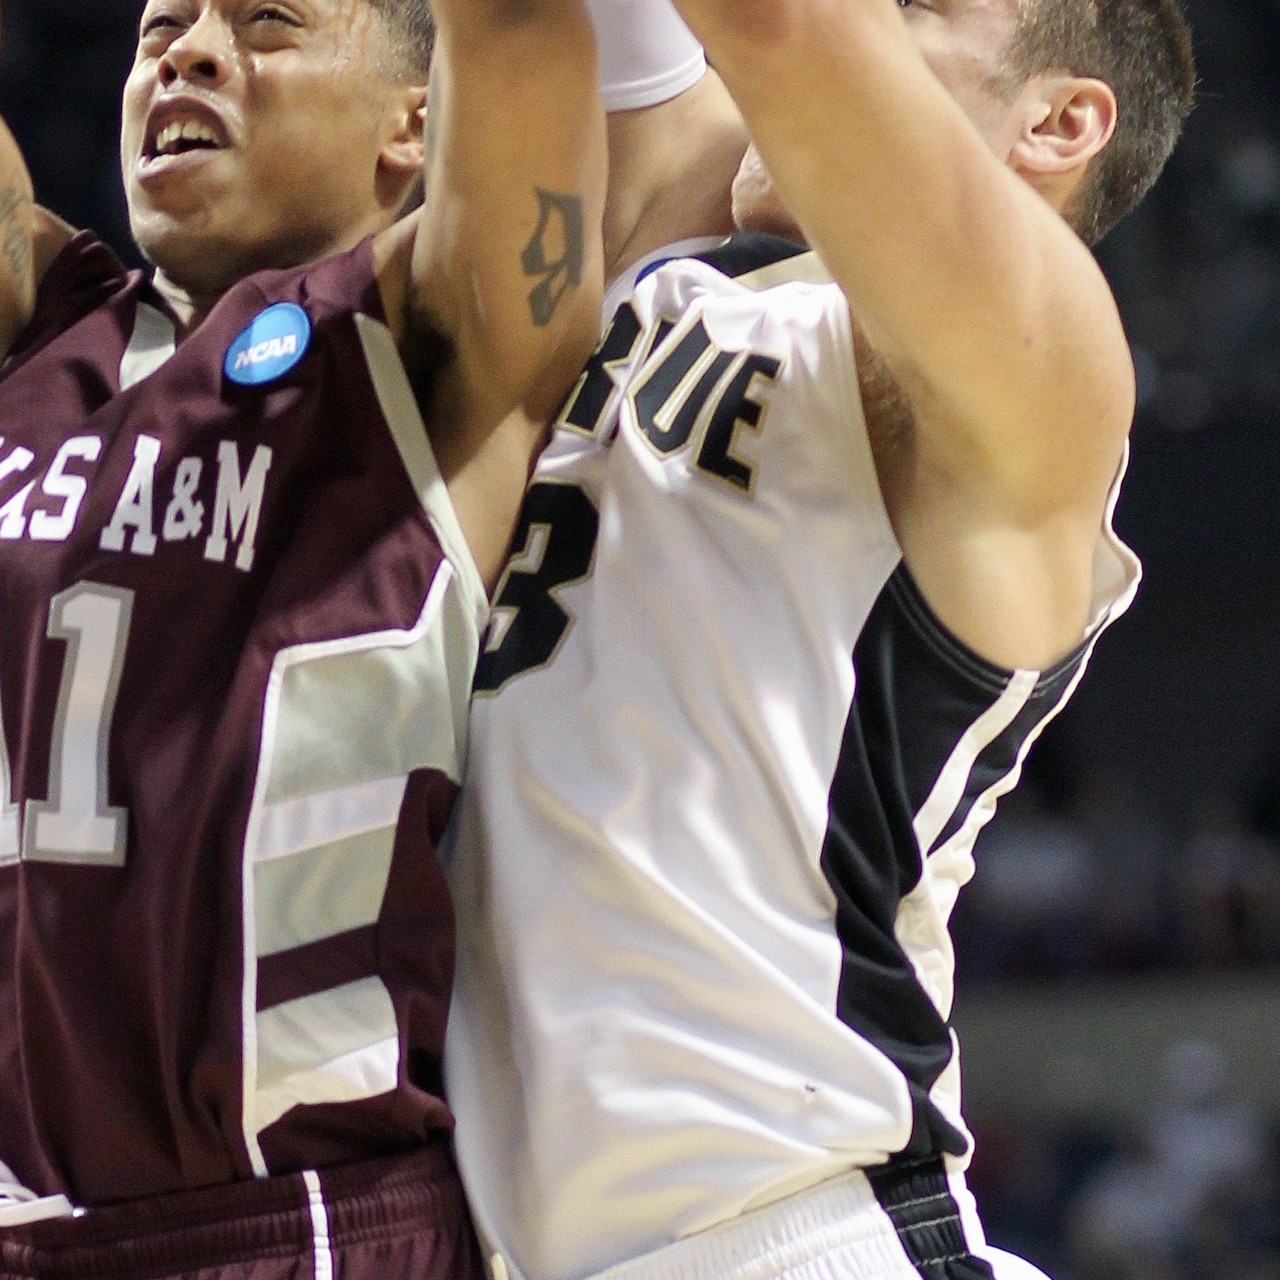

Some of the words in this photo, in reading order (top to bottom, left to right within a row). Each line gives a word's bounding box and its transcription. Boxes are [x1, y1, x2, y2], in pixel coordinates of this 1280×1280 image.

[232, 332, 297, 371] NCAA
[556, 300, 789, 499] RUE
[99, 433, 273, 573] A&M
